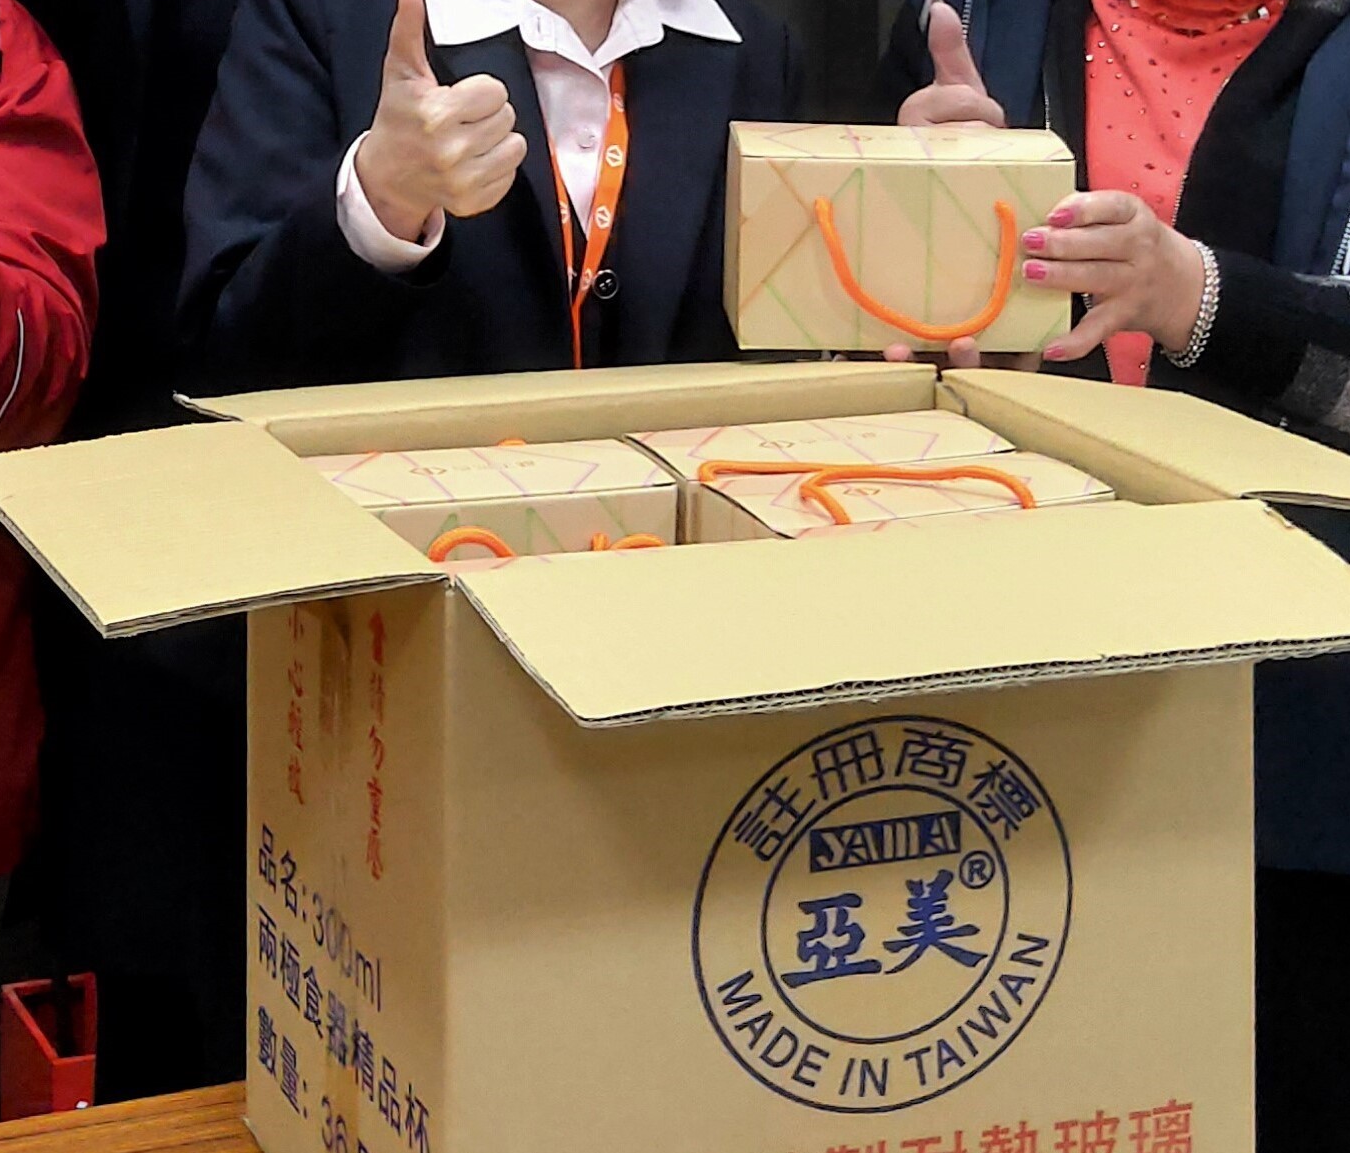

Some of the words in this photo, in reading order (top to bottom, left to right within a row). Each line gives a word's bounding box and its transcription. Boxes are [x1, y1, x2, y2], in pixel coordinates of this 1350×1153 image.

[732, 727, 1043, 862] 註冊商標
[780, 868, 989, 989] 亞美
[716, 969, 830, 1088] MADE
[838, 1057, 889, 1098] IN
[904, 932, 1051, 1086] TAIWAN
